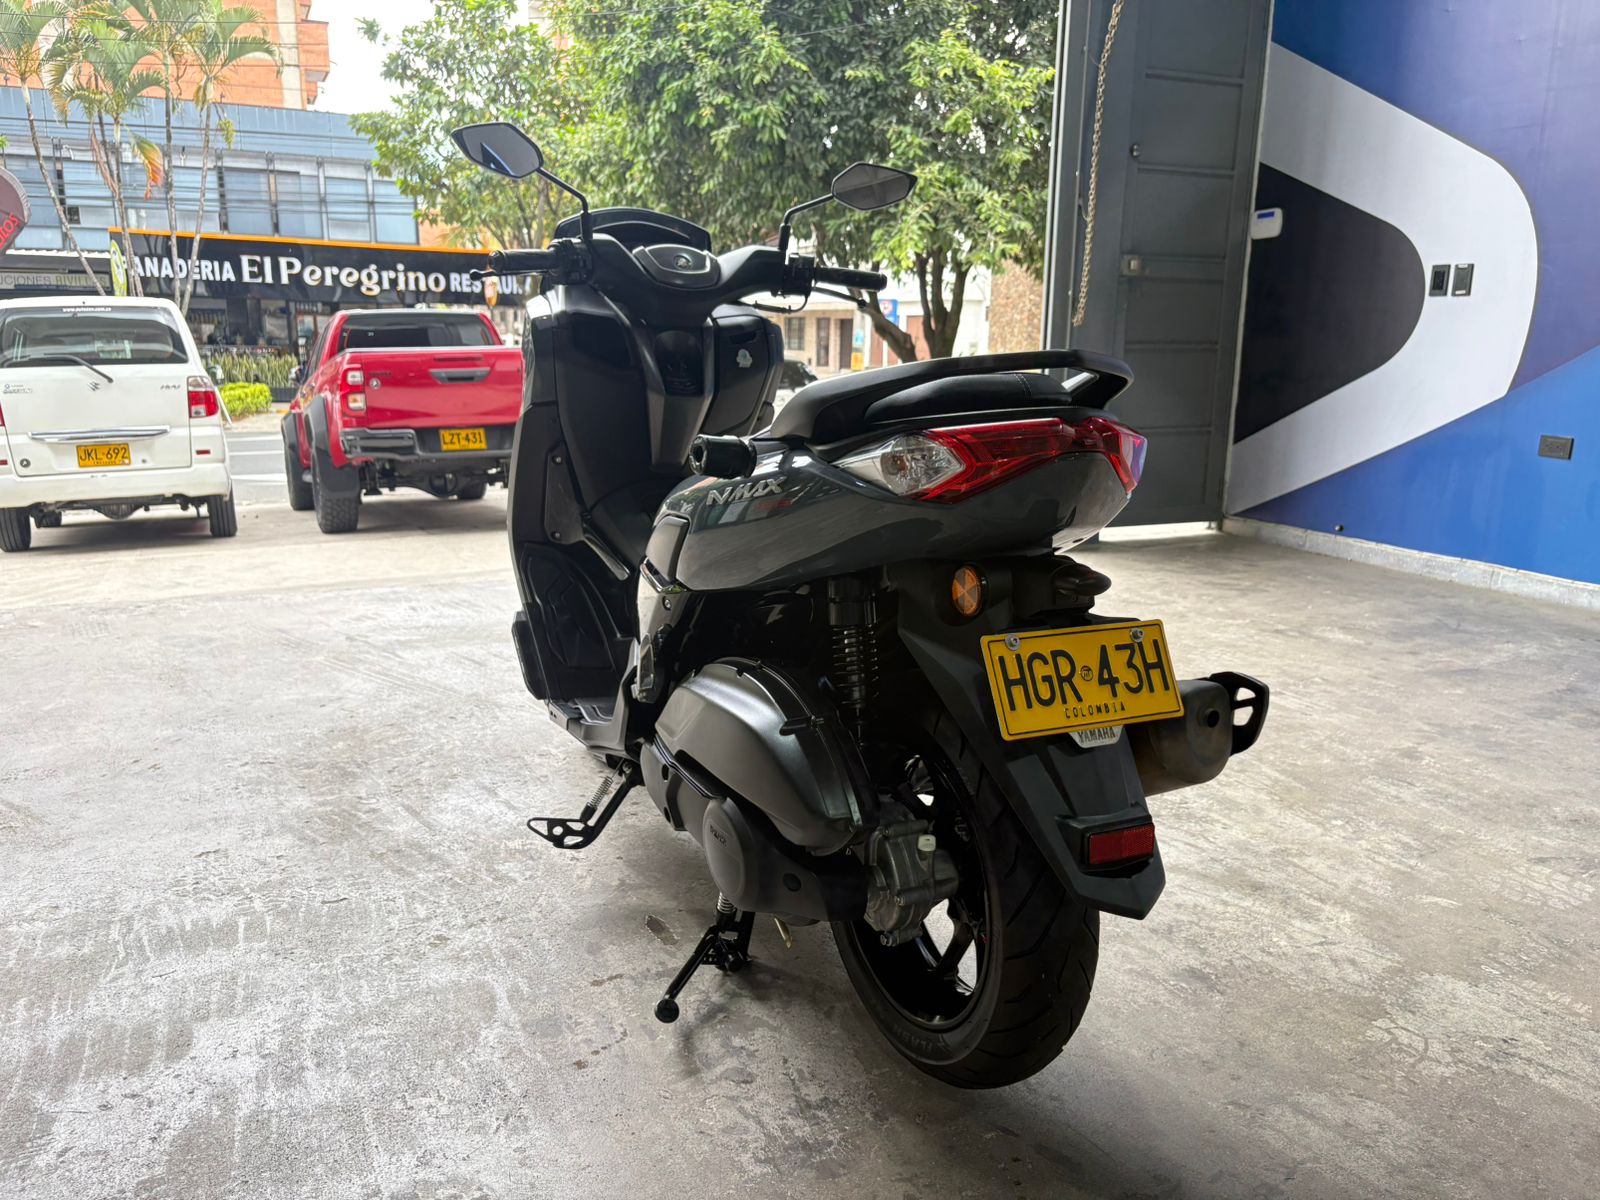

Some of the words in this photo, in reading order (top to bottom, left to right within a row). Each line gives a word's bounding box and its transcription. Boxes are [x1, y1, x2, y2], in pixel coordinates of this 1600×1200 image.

[239, 254, 274, 284] El
[278, 256, 446, 296] Peregrino
[706, 477, 787, 505] NMAX
[1064, 702, 1126, 719] COLOMBIA
[1077, 726, 1116, 743] YAMAHA
